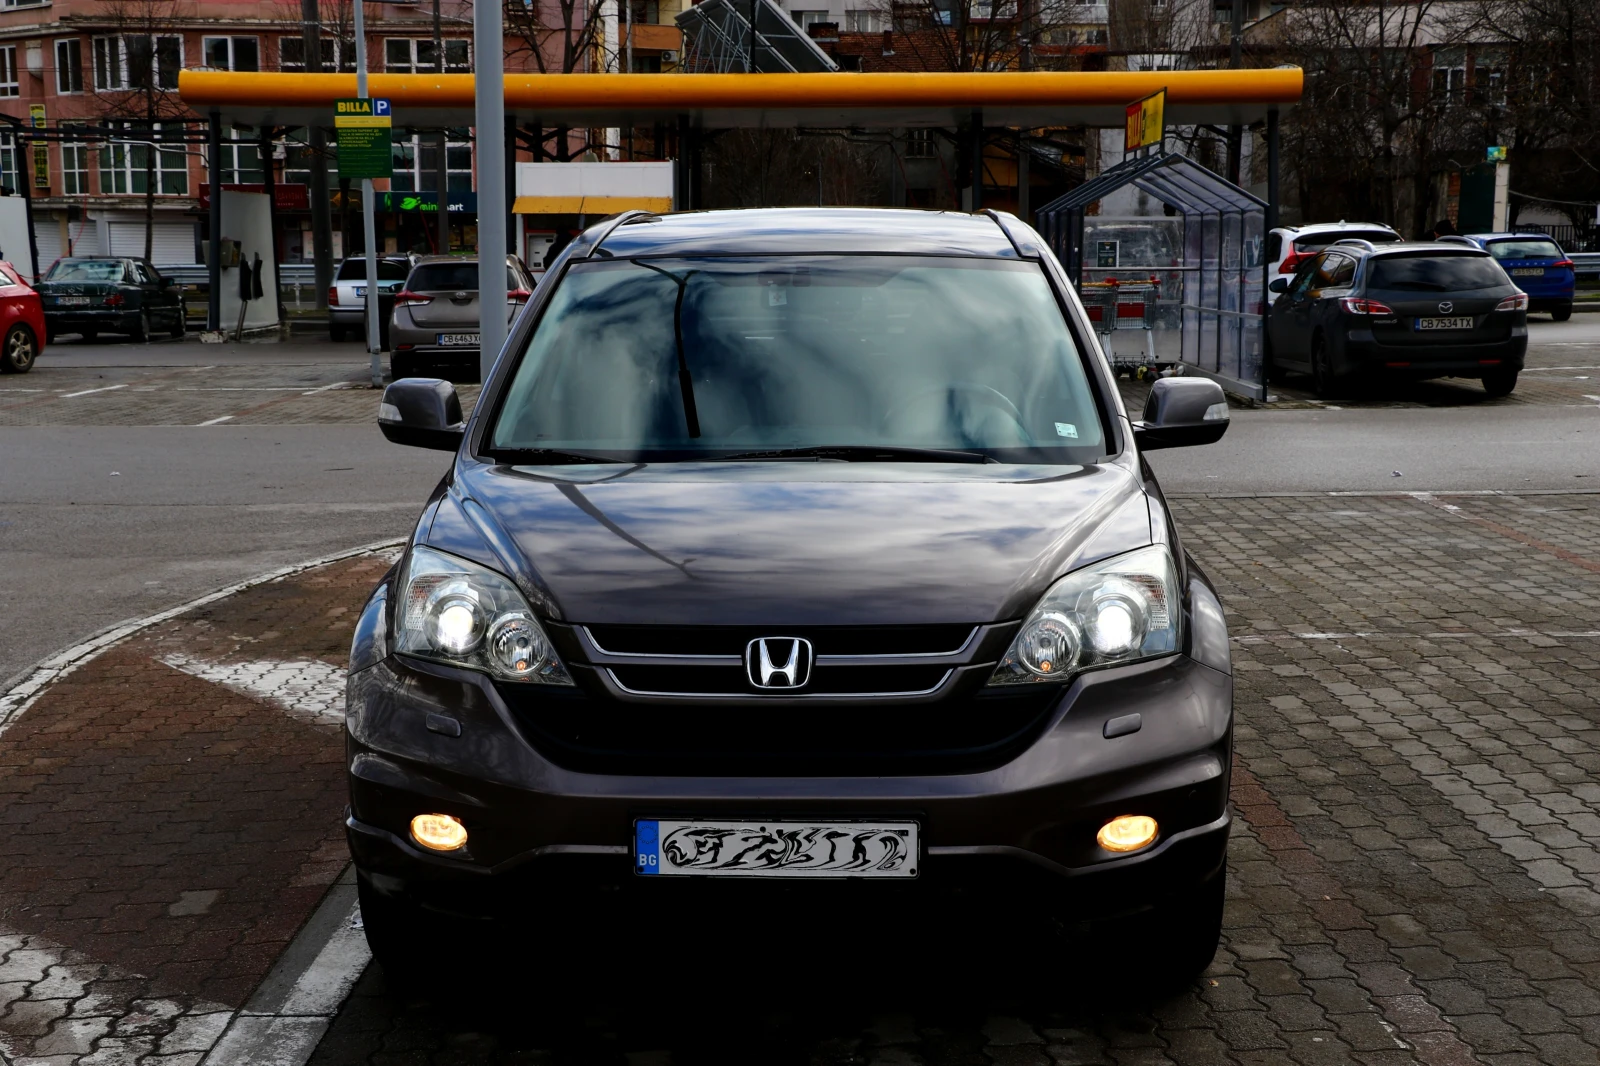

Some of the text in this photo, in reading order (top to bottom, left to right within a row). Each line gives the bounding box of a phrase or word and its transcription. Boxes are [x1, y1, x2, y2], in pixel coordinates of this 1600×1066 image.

[337, 101, 388, 114] BILLA P
[1421, 320, 1434, 329] CB
[1435, 319, 1458, 328] 7534
[1459, 318, 1471, 328] TX
[444, 335, 454, 343] CB
[454, 335, 473, 343] 6463
[639, 853, 657, 866] BG
